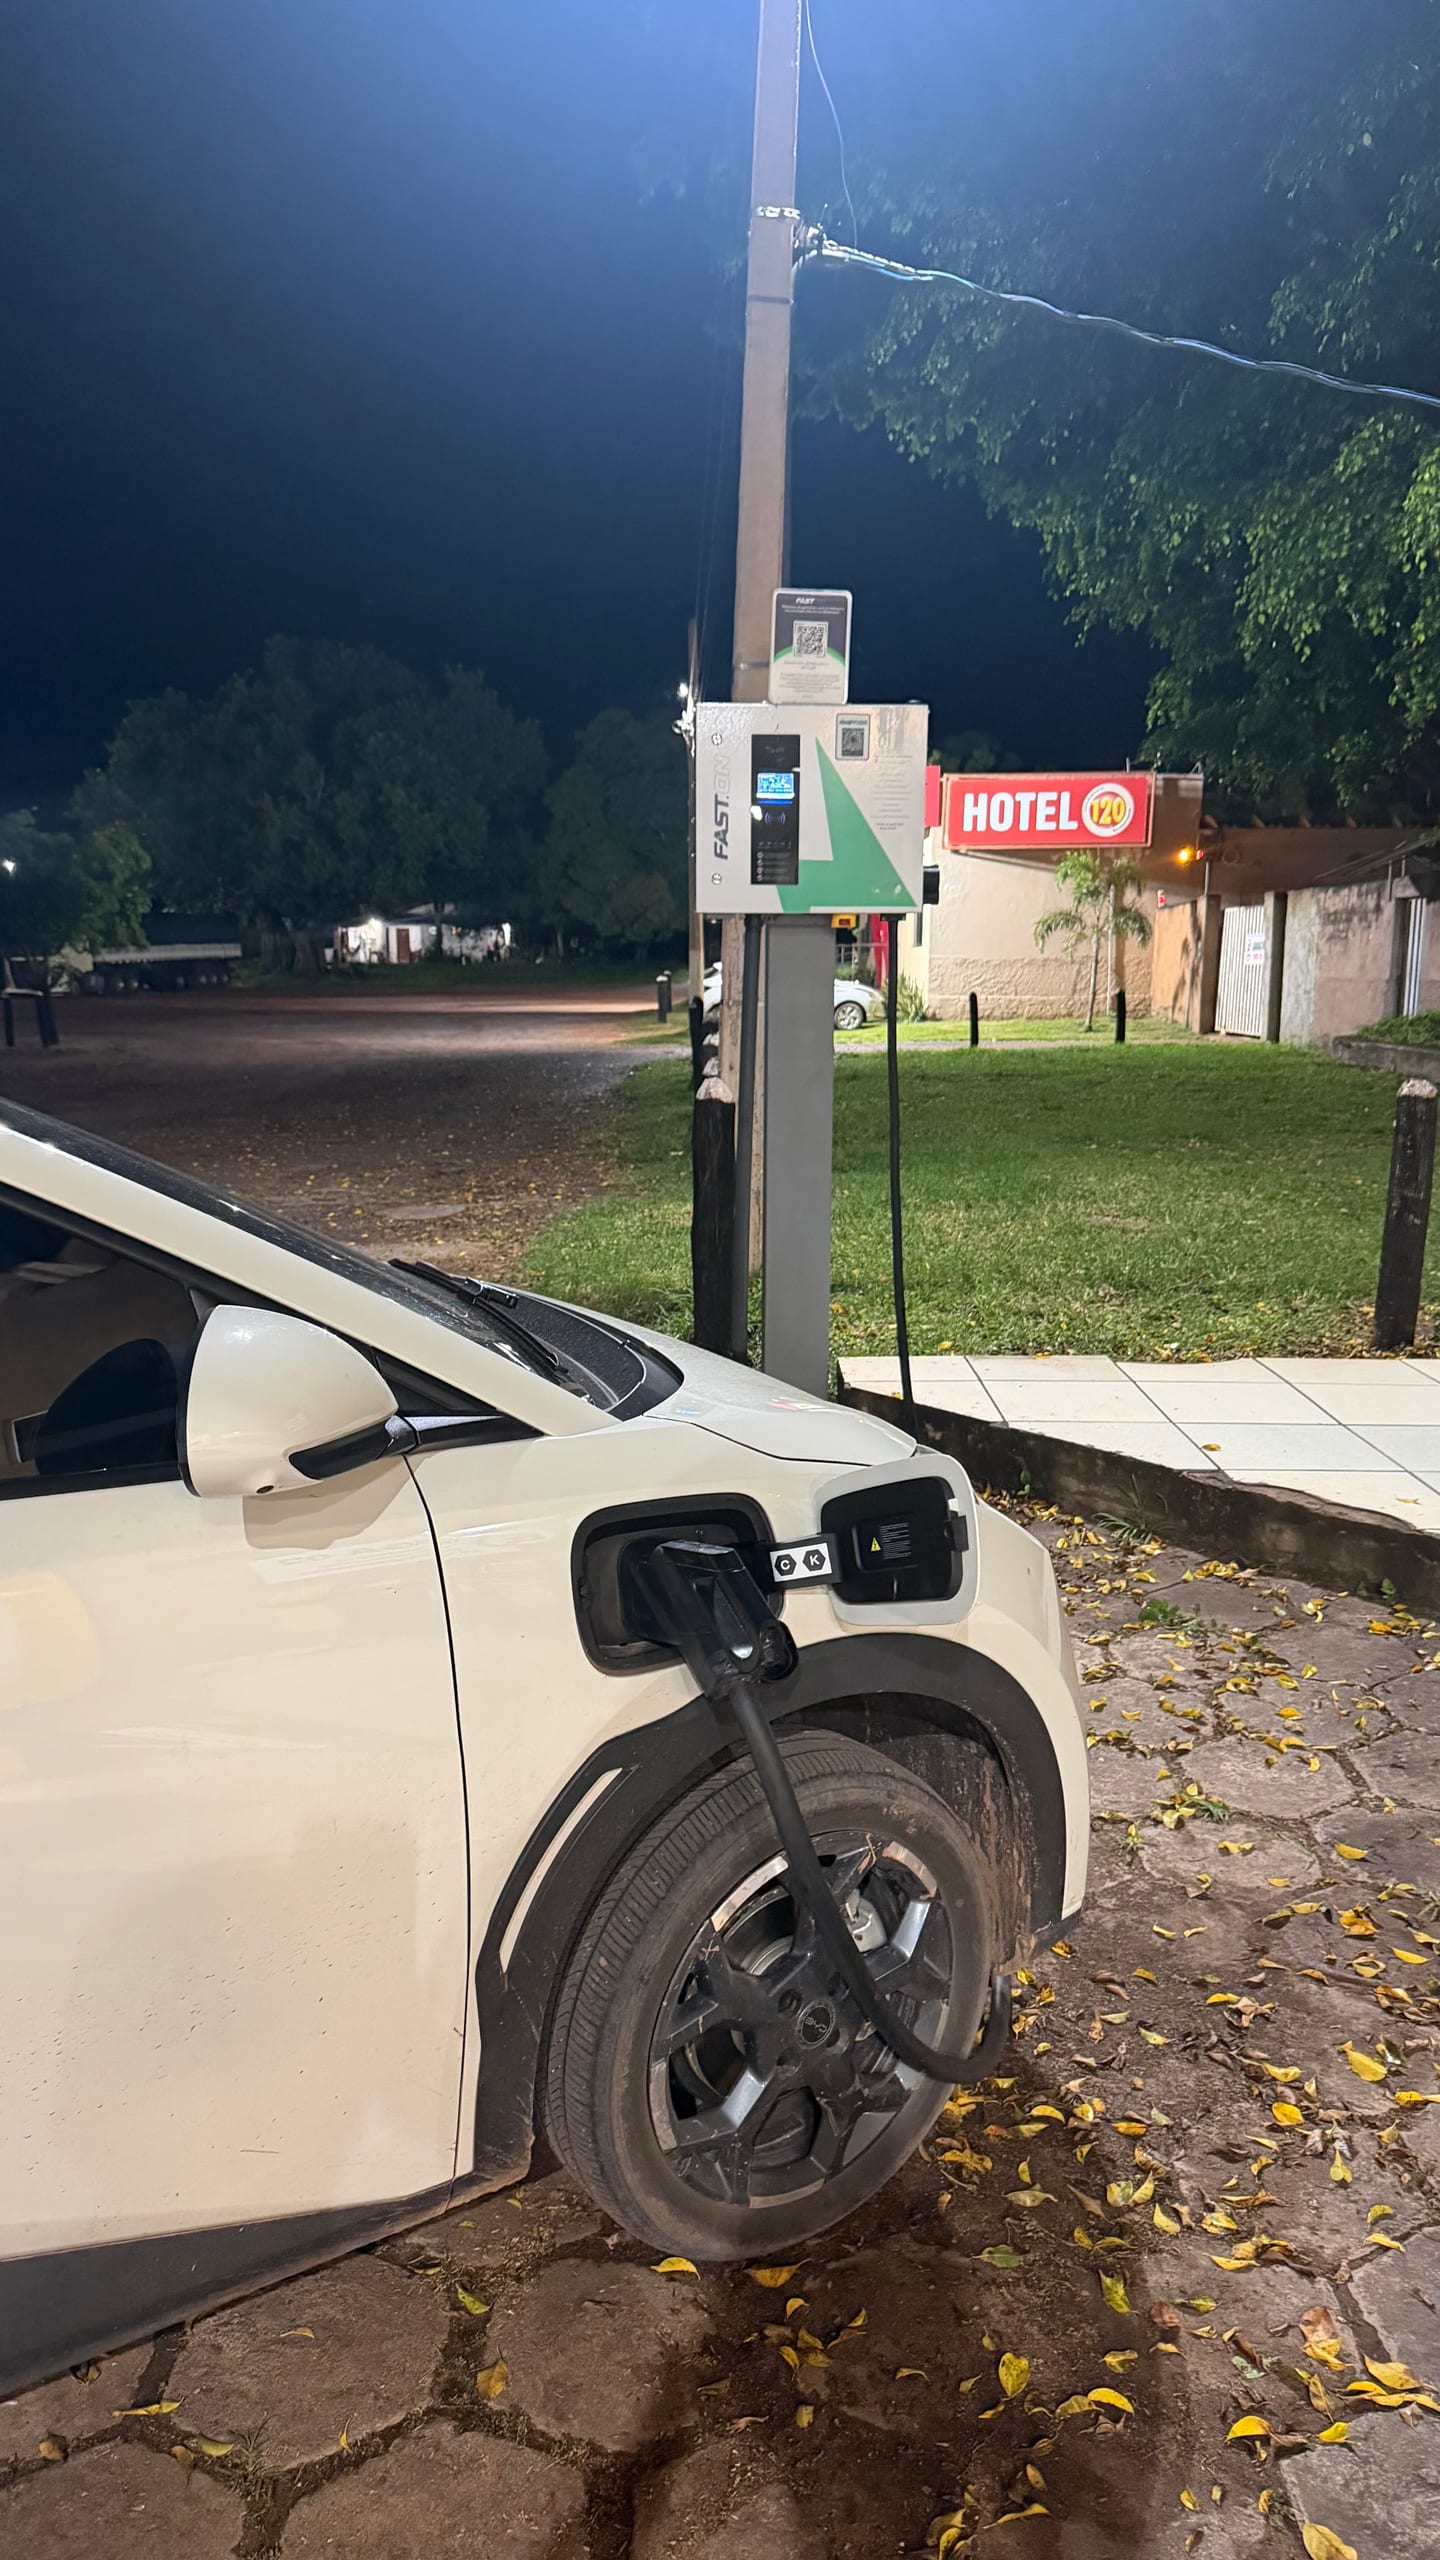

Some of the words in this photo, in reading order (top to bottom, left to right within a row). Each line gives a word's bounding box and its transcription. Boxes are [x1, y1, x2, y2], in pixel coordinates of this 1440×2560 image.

[962, 791, 1079, 832] HOTEL
[1091, 796, 1127, 826] 120
[780, 1559, 791, 1571] C
[809, 1554, 820, 1566] K
[805, 2017, 827, 2032] BYD
